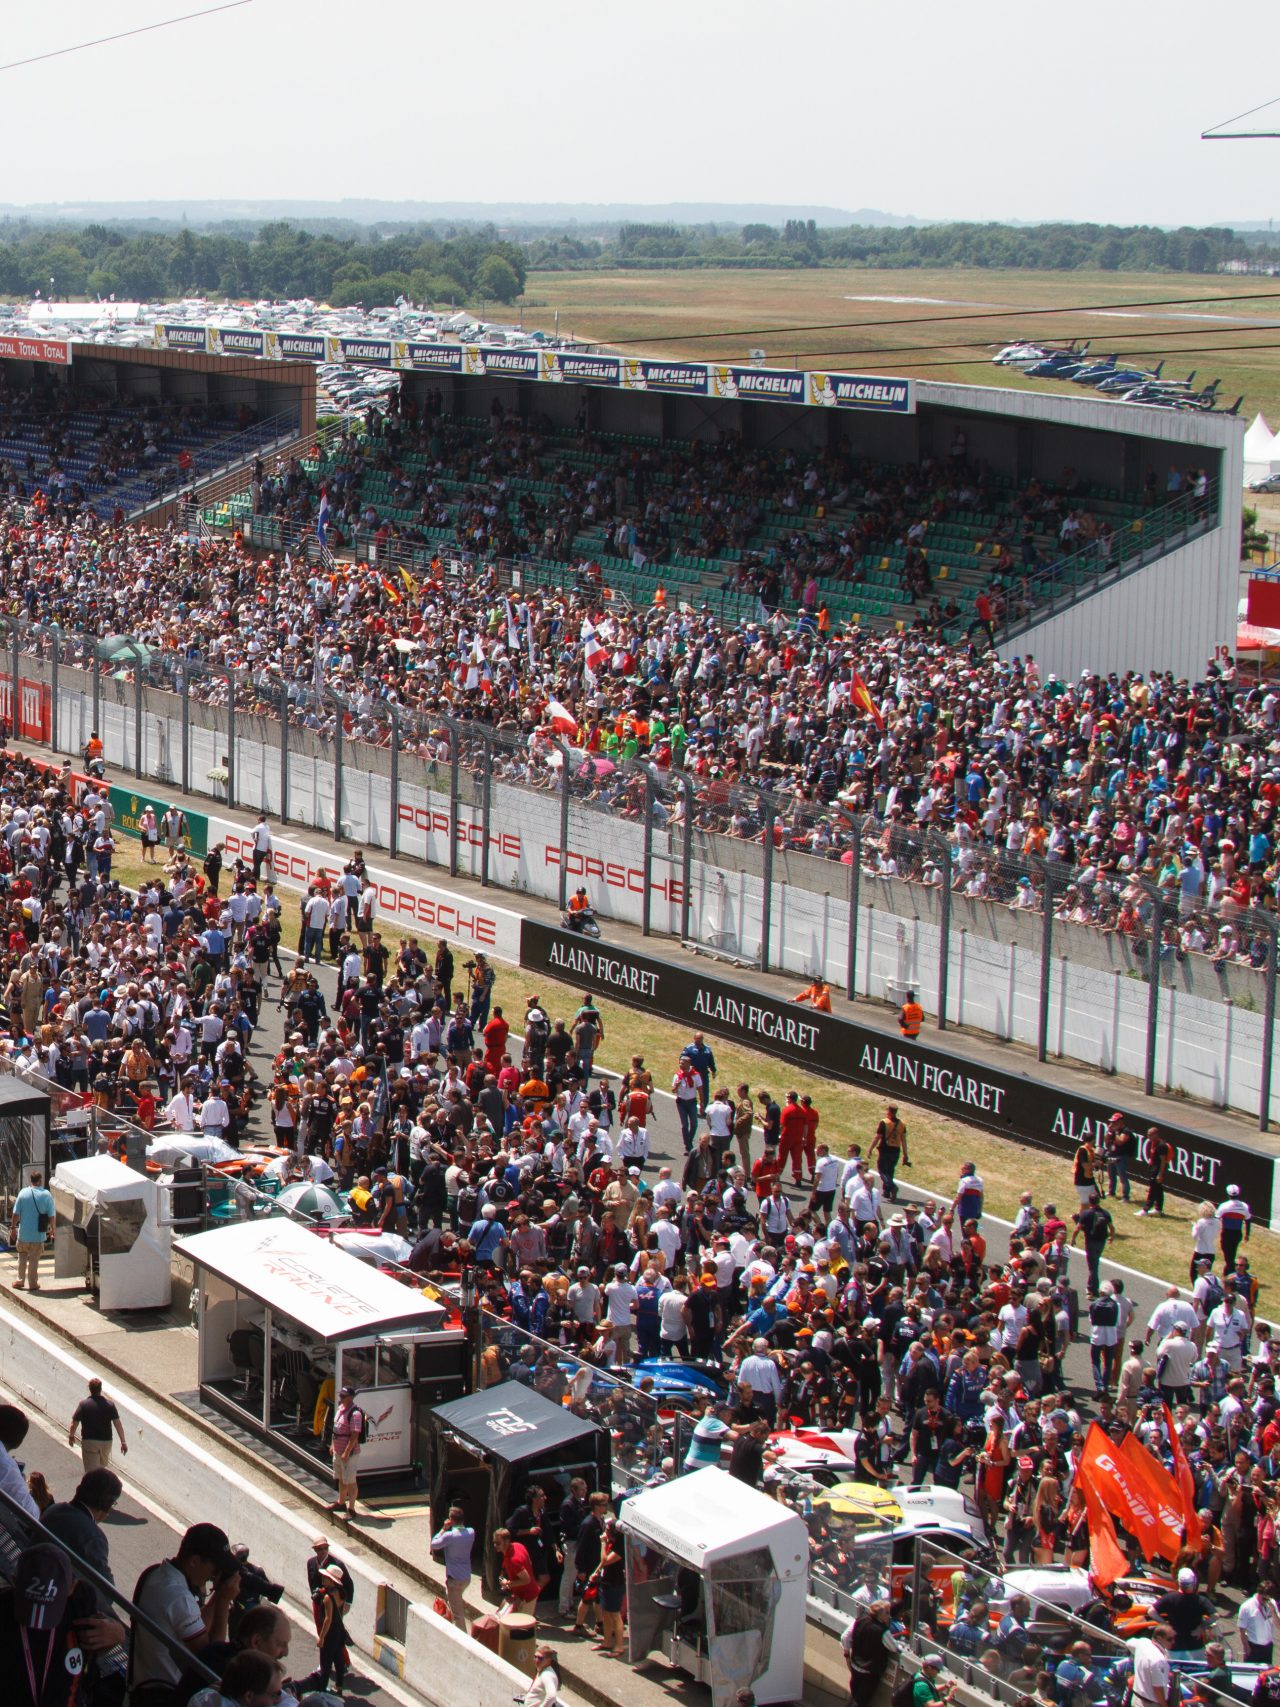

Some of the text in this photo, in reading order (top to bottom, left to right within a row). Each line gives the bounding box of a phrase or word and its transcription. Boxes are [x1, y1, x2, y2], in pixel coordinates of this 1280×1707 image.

[168, 330, 205, 344] MICHELIN
[223, 334, 262, 349] MICHELIN
[18, 342, 40, 357] TOTAL
[43, 343, 65, 359] TOTAL
[282, 339, 323, 354] MICHELIN
[345, 344, 390, 358] MICHELIN
[413, 349, 460, 364] MICHELIN
[486, 353, 536, 370] MICHELIN
[564, 360, 617, 378] MICHELIN
[647, 368, 706, 385] MICHELIN
[739, 375, 802, 393] MICHELIN
[837, 382, 906, 402] MICHELIN
[22, 685, 41, 728] RTL
[398, 803, 520, 859] PORSCHE
[545, 846, 692, 907] PORSCHE
[549, 941, 659, 997] ALAIN FIGARET
[693, 989, 820, 1051] ALAIN FIGARET
[859, 1044, 1005, 1114] ALAIN FIGARET
[263, 1262, 360, 1316] RACING
[277, 1257, 379, 1313] CORVETTE
